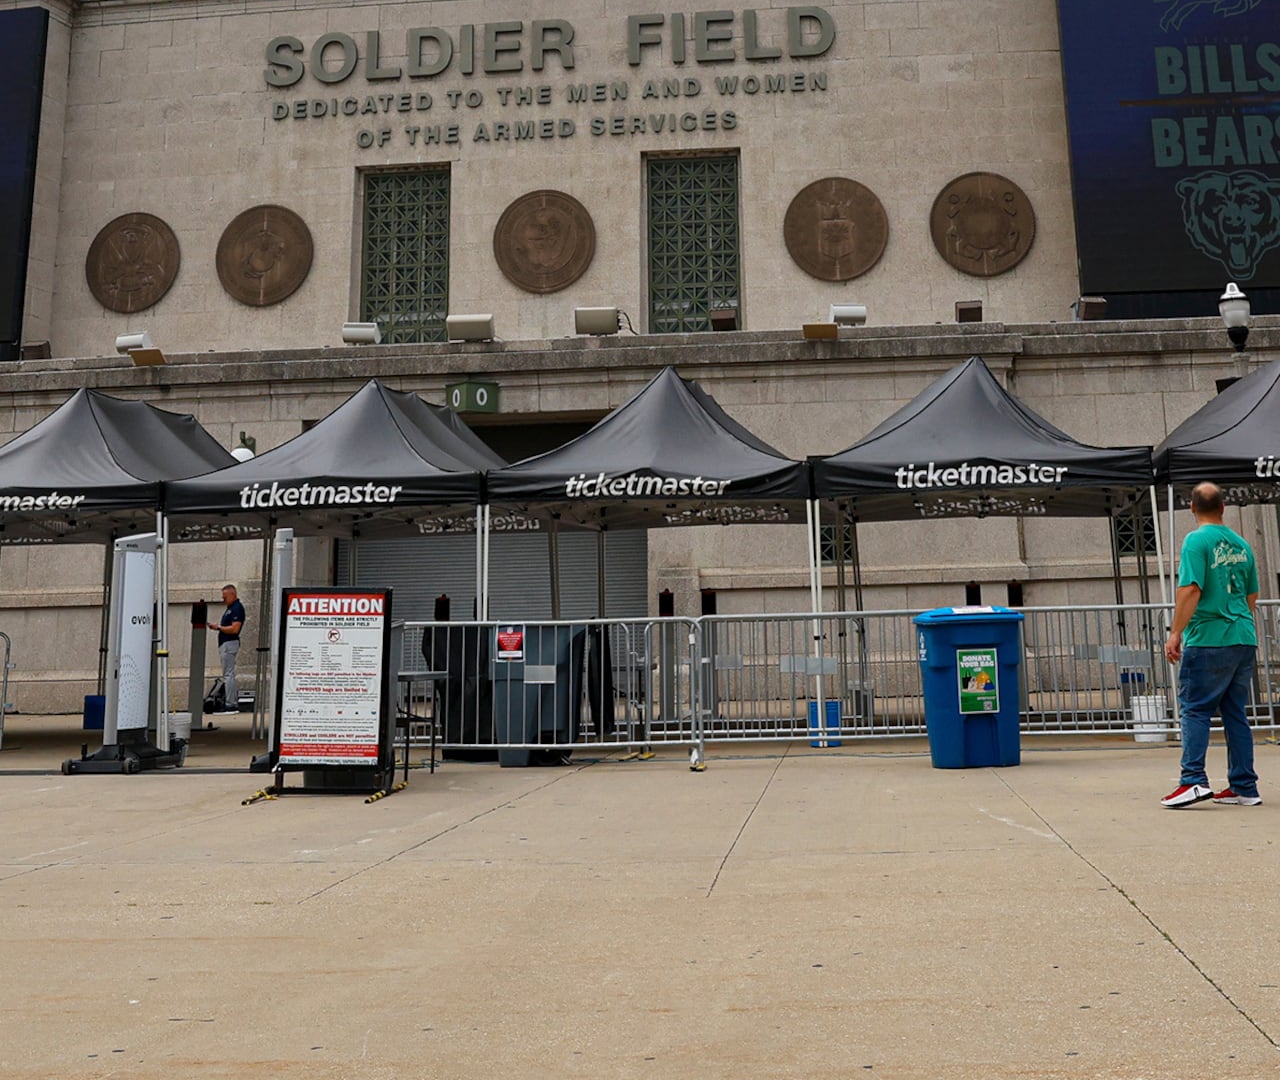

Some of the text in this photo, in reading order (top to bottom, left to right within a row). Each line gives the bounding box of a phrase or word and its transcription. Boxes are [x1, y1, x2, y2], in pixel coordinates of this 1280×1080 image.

[263, 6, 836, 87] SOLDIER FIELD
[272, 72, 828, 121] DEDICATED TO THE MEN AND WOMEN
[356, 110, 737, 148] OF THE ARMED SERVICES
[564, 472, 731, 498] ticketmaster
[894, 461, 1068, 490] ticketmaster
[239, 481, 402, 509] ticketmaster
[288, 598, 383, 613] ATTENTION
